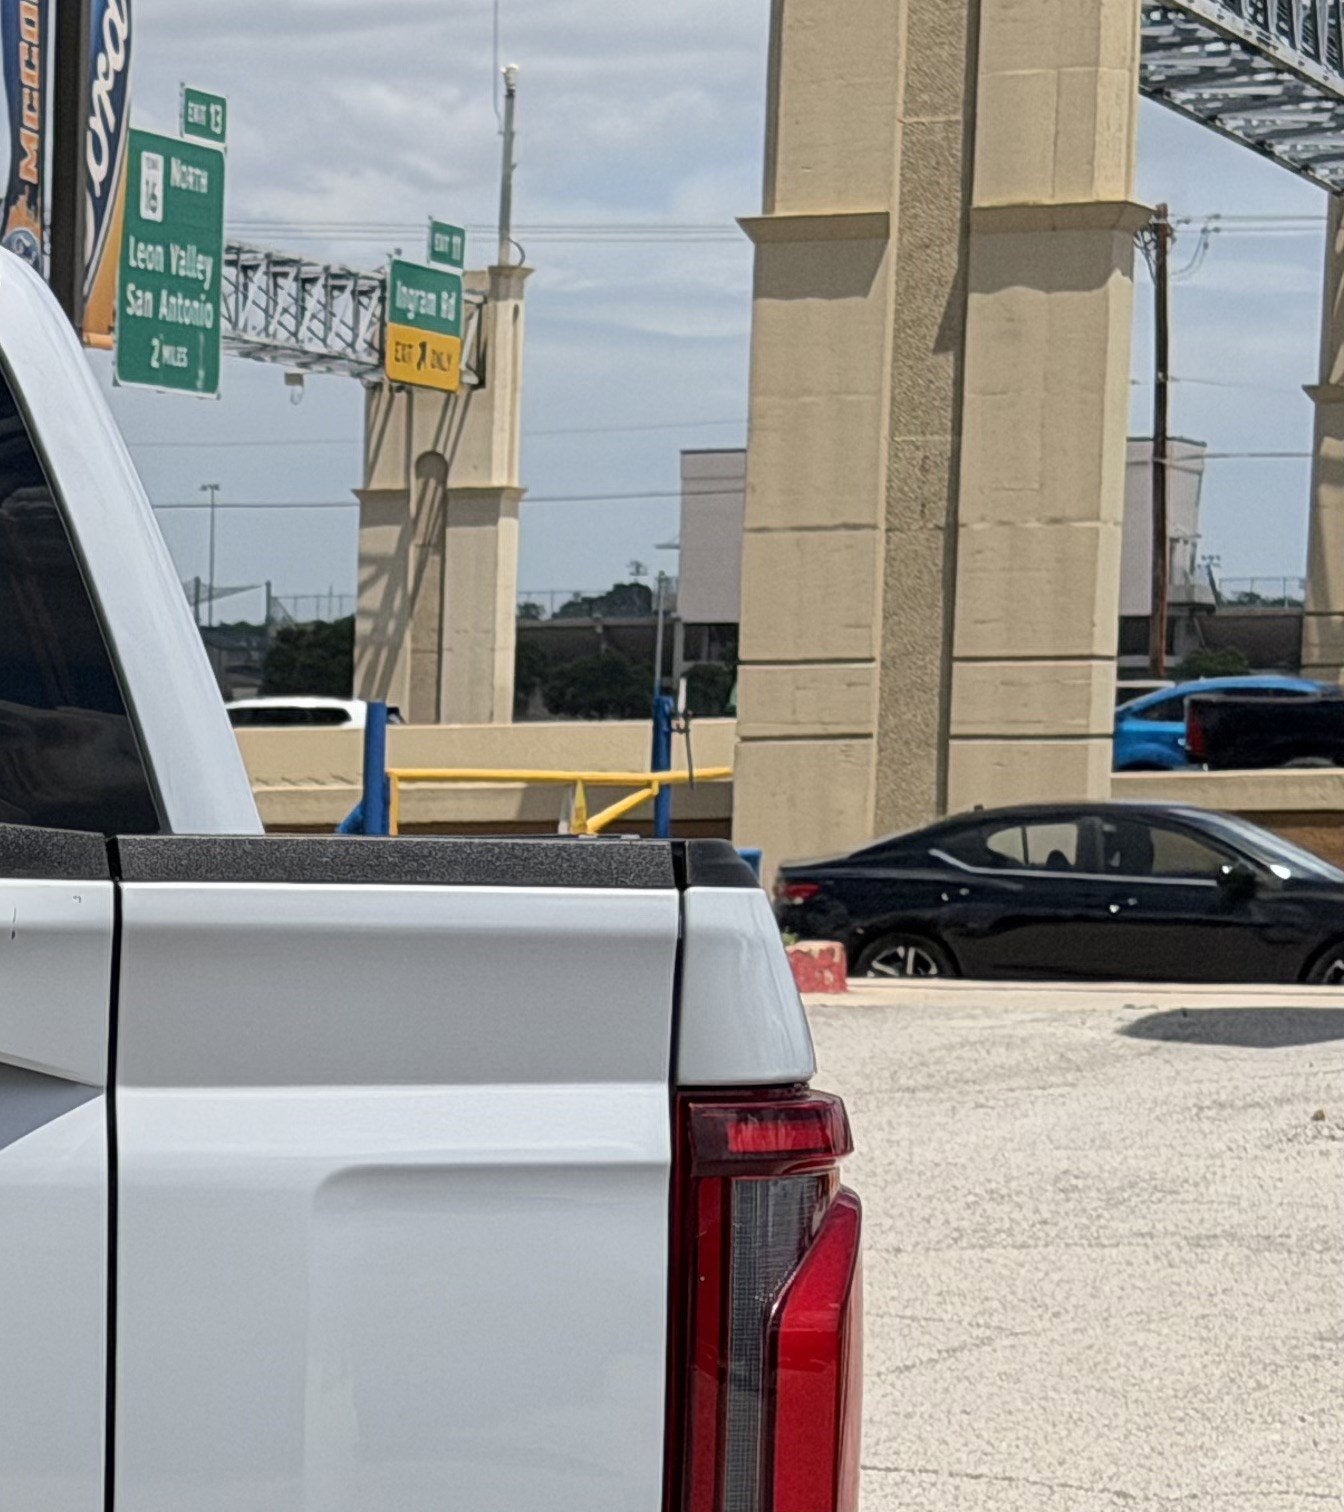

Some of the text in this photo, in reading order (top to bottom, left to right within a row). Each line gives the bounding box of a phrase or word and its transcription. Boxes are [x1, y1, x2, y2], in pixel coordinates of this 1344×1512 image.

[19, 0, 40, 185] MCCO
[187, 102, 207, 126] EXIT
[145, 179, 158, 213] 16
[129, 235, 213, 290] Leon Valley
[126, 283, 214, 329] San Antonio
[395, 280, 456, 321] Ingram Rd
[150, 338, 188, 369] 2 MILES
[394, 340, 414, 364] EXIT
